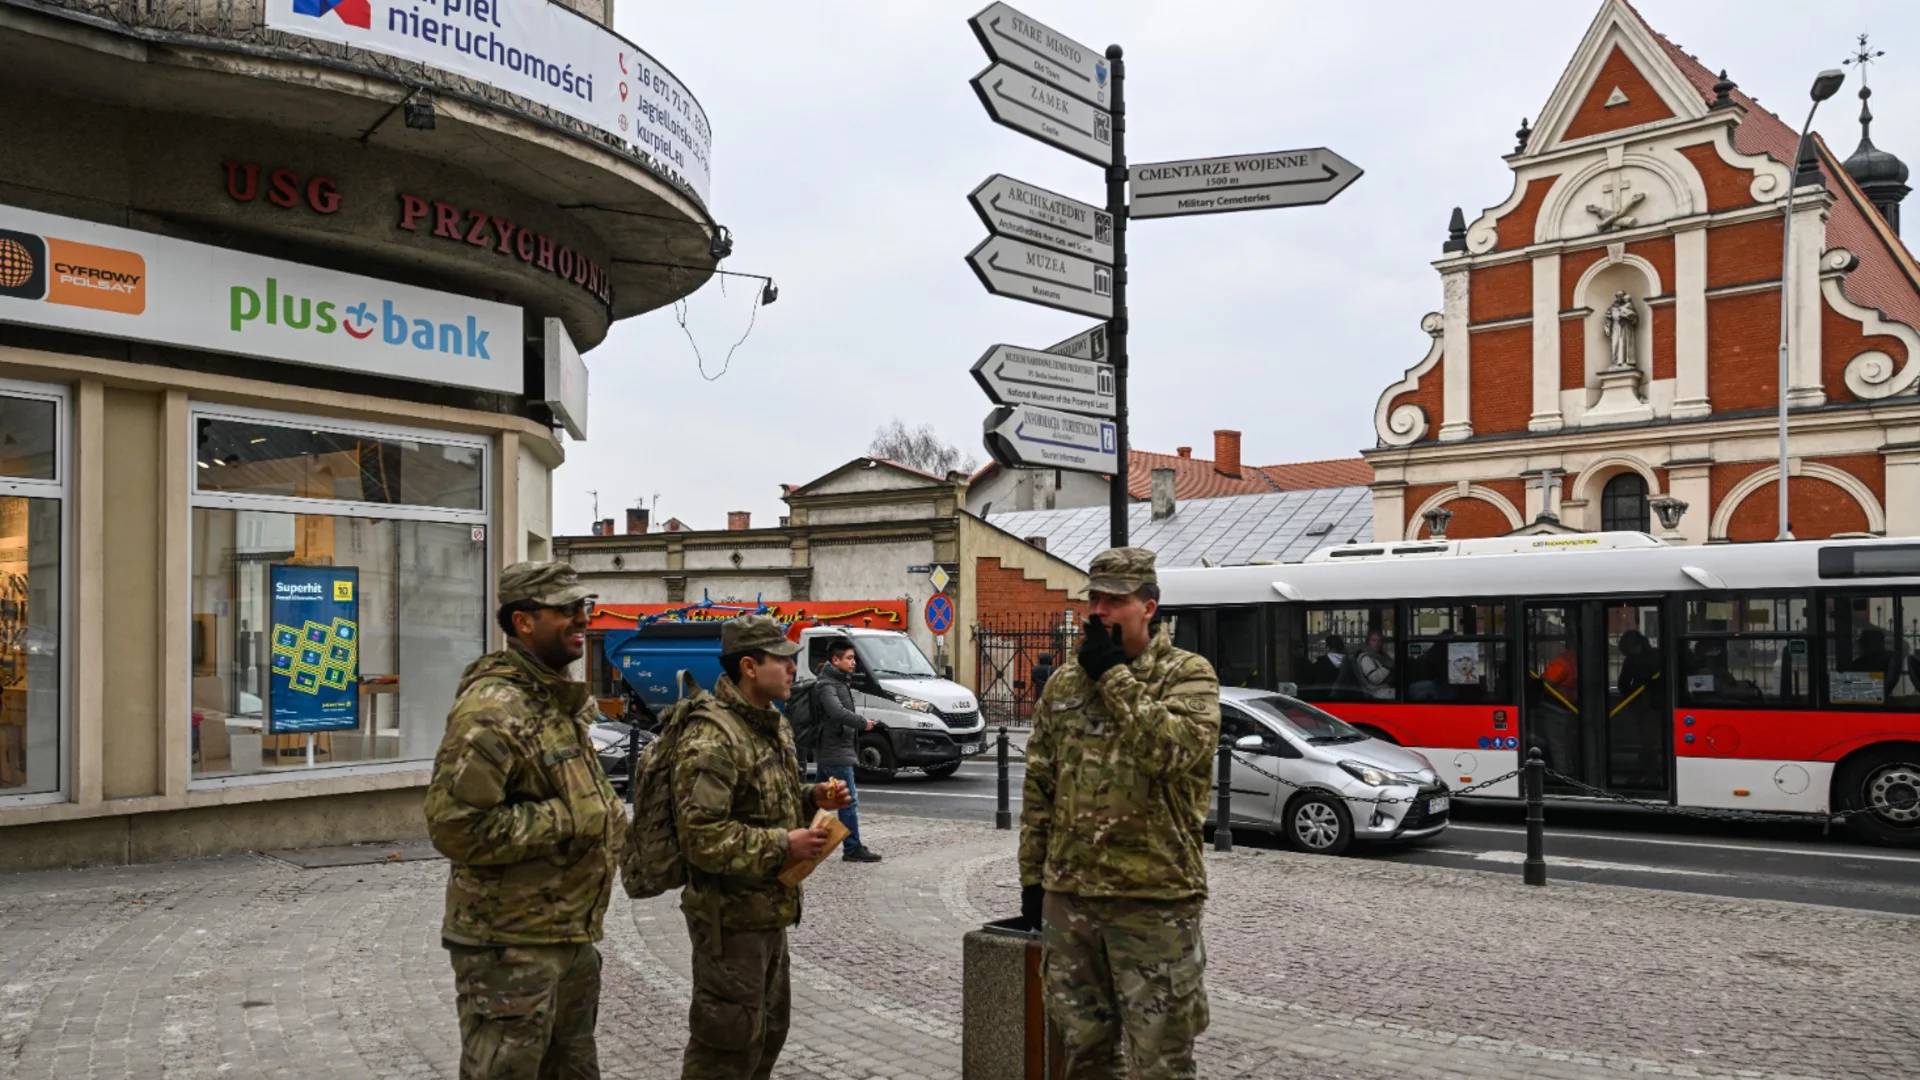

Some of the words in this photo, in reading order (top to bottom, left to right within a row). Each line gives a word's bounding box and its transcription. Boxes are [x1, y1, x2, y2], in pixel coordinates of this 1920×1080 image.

[418, 0, 501, 28] piel
[1012, 17, 1042, 44] STARE
[1046, 34, 1082, 64] MIASTO
[389, 6, 593, 103] nieruchomości
[1034, 60, 1045, 73] Old
[1046, 64, 1060, 81] Town
[1031, 86, 1068, 114] ZAMEK
[1041, 123, 1059, 136] Castle
[1138, 162, 1230, 181] CMENTARZE
[1234, 154, 1308, 172] WOJENNE
[1206, 176, 1228, 186] 1500
[1008, 187, 1087, 222] ARCHIKATEDRY
[1178, 197, 1215, 209] Military
[1217, 192, 1270, 206] Cemeteries
[225, 161, 342, 214] USG
[400, 193, 611, 305] PRZYCHODNIA
[54, 262, 140, 285] CYFROWY
[1026, 252, 1066, 274] MUZEA
[60, 274, 136, 294] POLSAT
[1032, 285, 1060, 300] Museums
[230, 277, 336, 334] plus
[383, 300, 490, 360] bank
[1007, 388, 1030, 398] National
[1032, 391, 1054, 402] Museum
[1056, 394, 1062, 402] of
[1062, 394, 1070, 404] the
[1096, 400, 1109, 410] Land
[1024, 412, 1060, 430] INFORMACJA
[1041, 448, 1058, 460] Tourist
[276, 582, 322, 594] Superhit
[338, 586, 348, 596] 10
